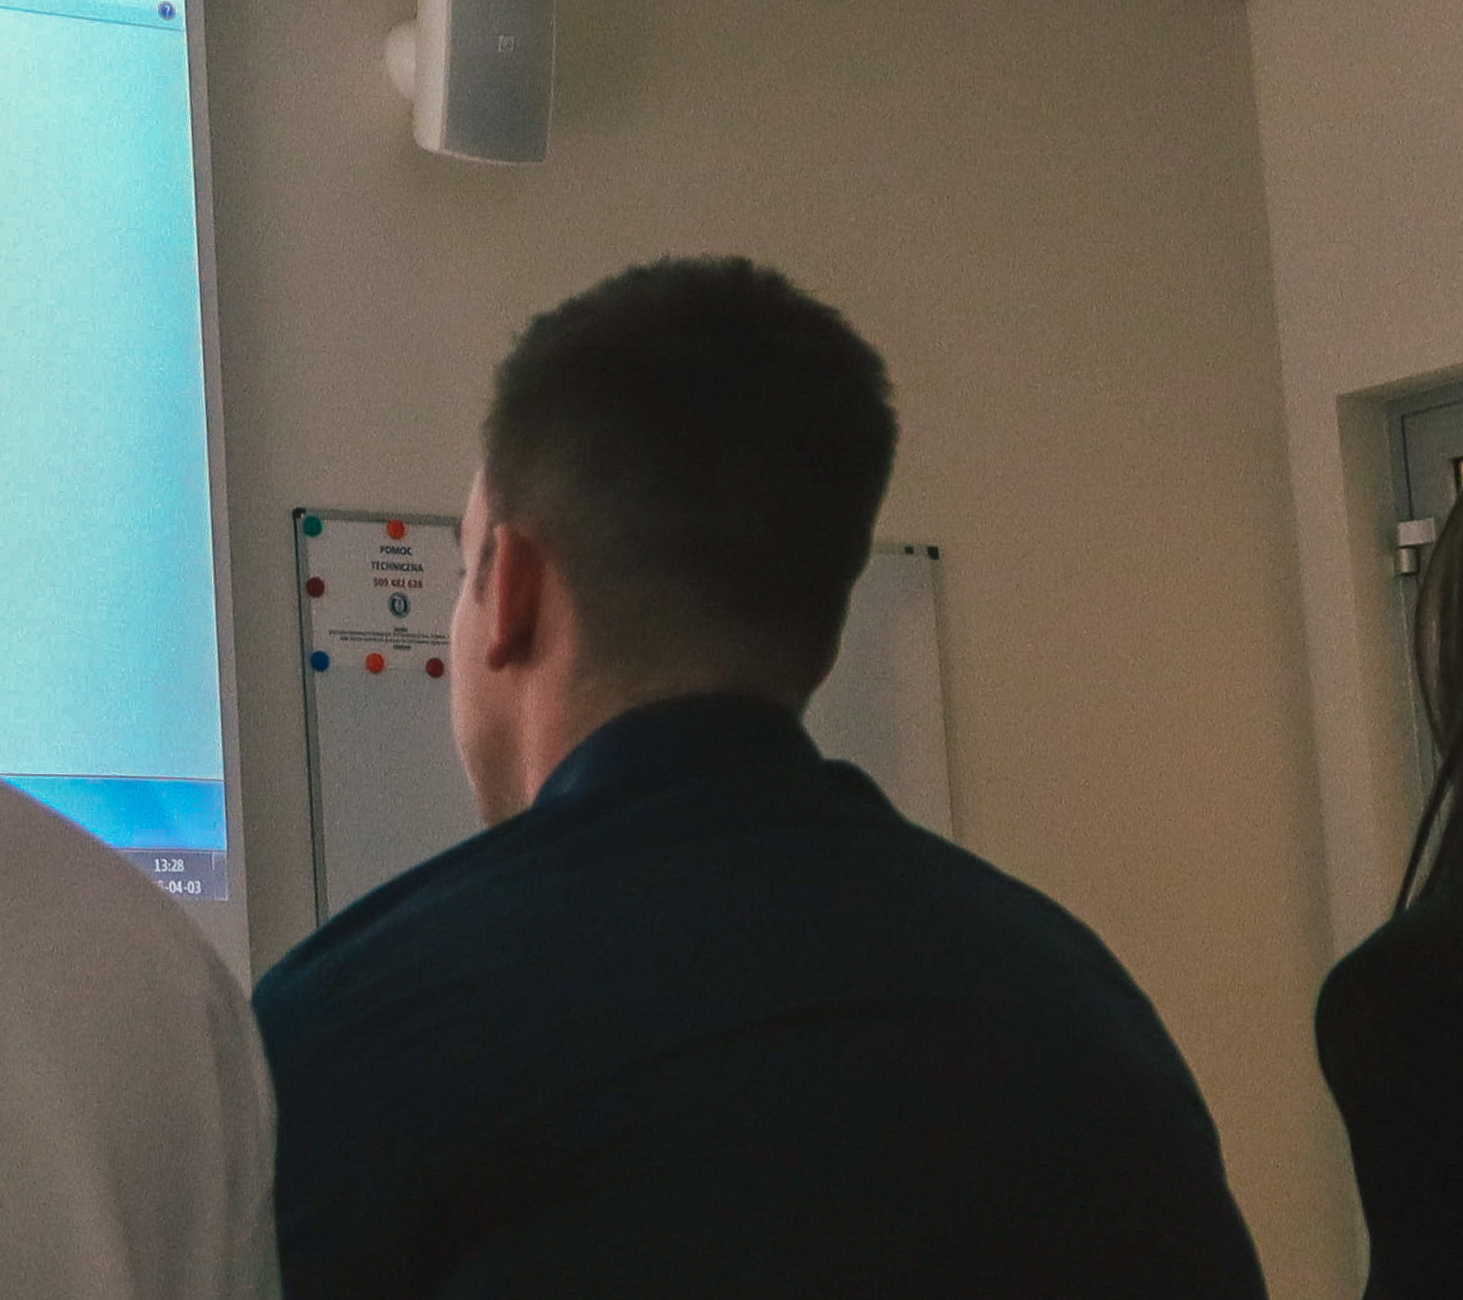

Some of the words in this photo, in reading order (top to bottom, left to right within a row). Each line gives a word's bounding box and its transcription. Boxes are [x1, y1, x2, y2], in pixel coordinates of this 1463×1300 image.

[379, 545, 413, 556] POMOC
[370, 560, 424, 572] TECHNICZNA
[155, 858, 185, 873] 13:28
